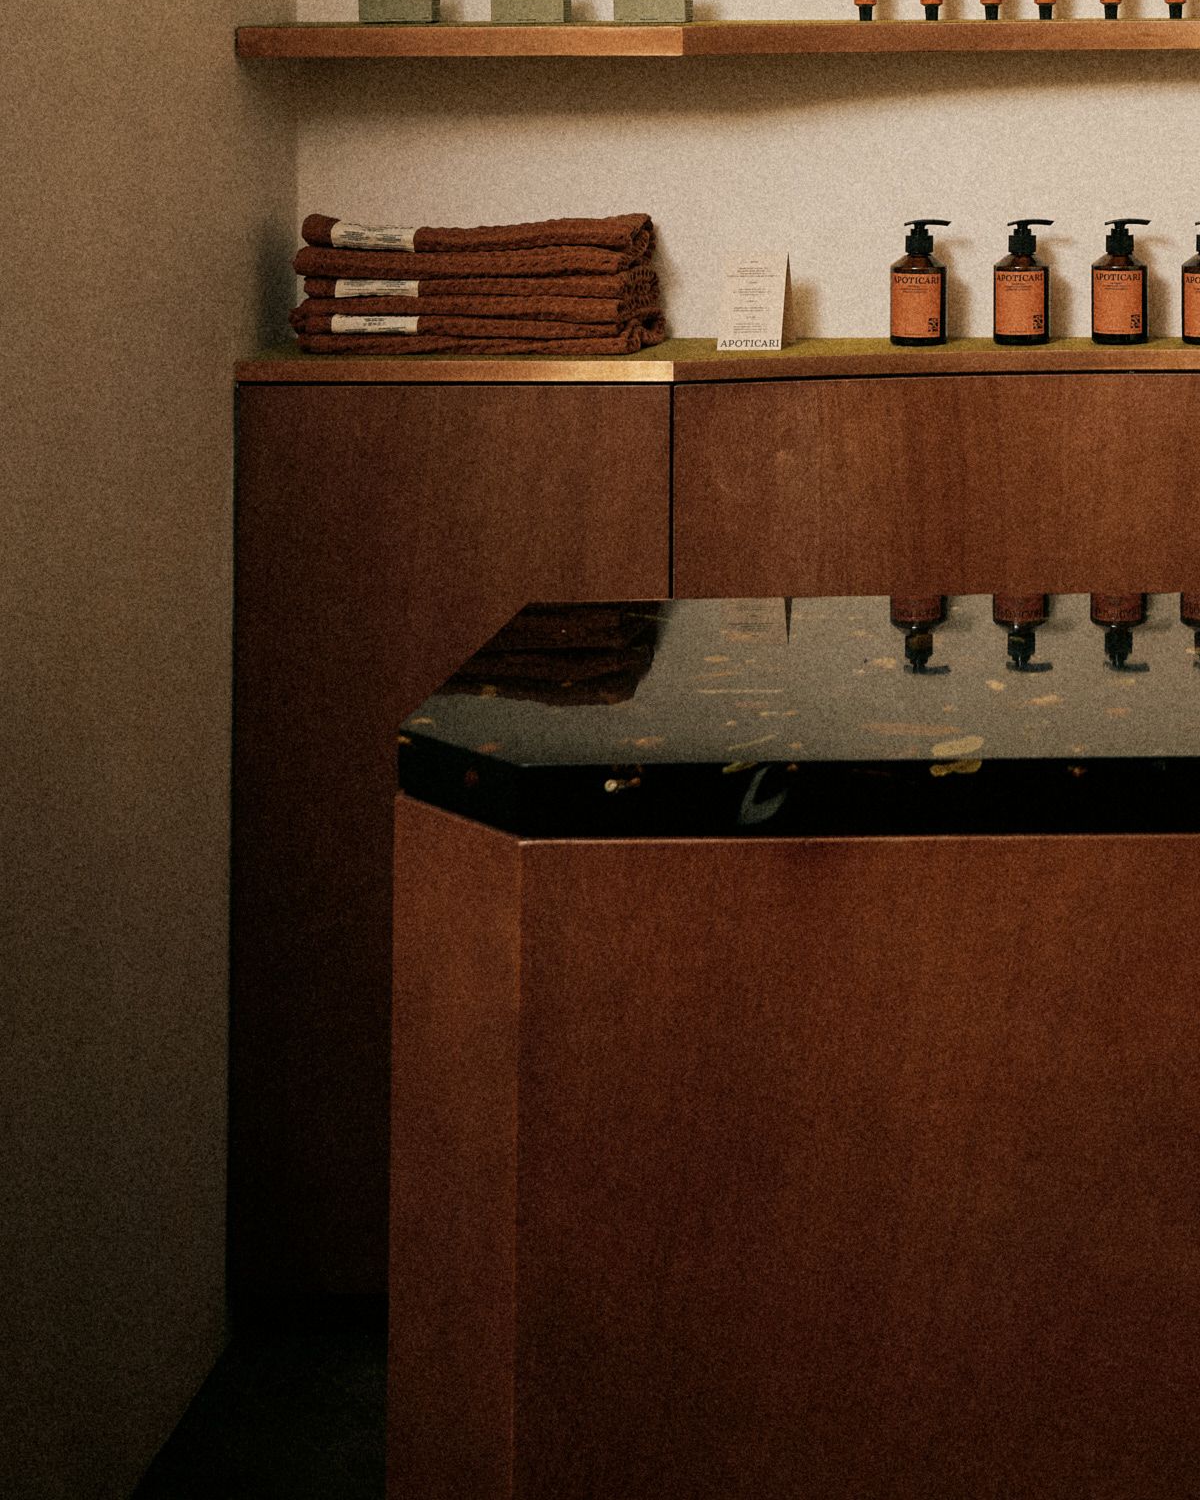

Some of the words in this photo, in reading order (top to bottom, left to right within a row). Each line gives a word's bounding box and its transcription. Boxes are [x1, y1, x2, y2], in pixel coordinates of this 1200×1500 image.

[894, 276, 939, 284] APOTICARI
[997, 273, 1042, 281] APOTICARI
[1095, 273, 1141, 281] APOTICARI
[720, 339, 779, 348] APOTICARI
